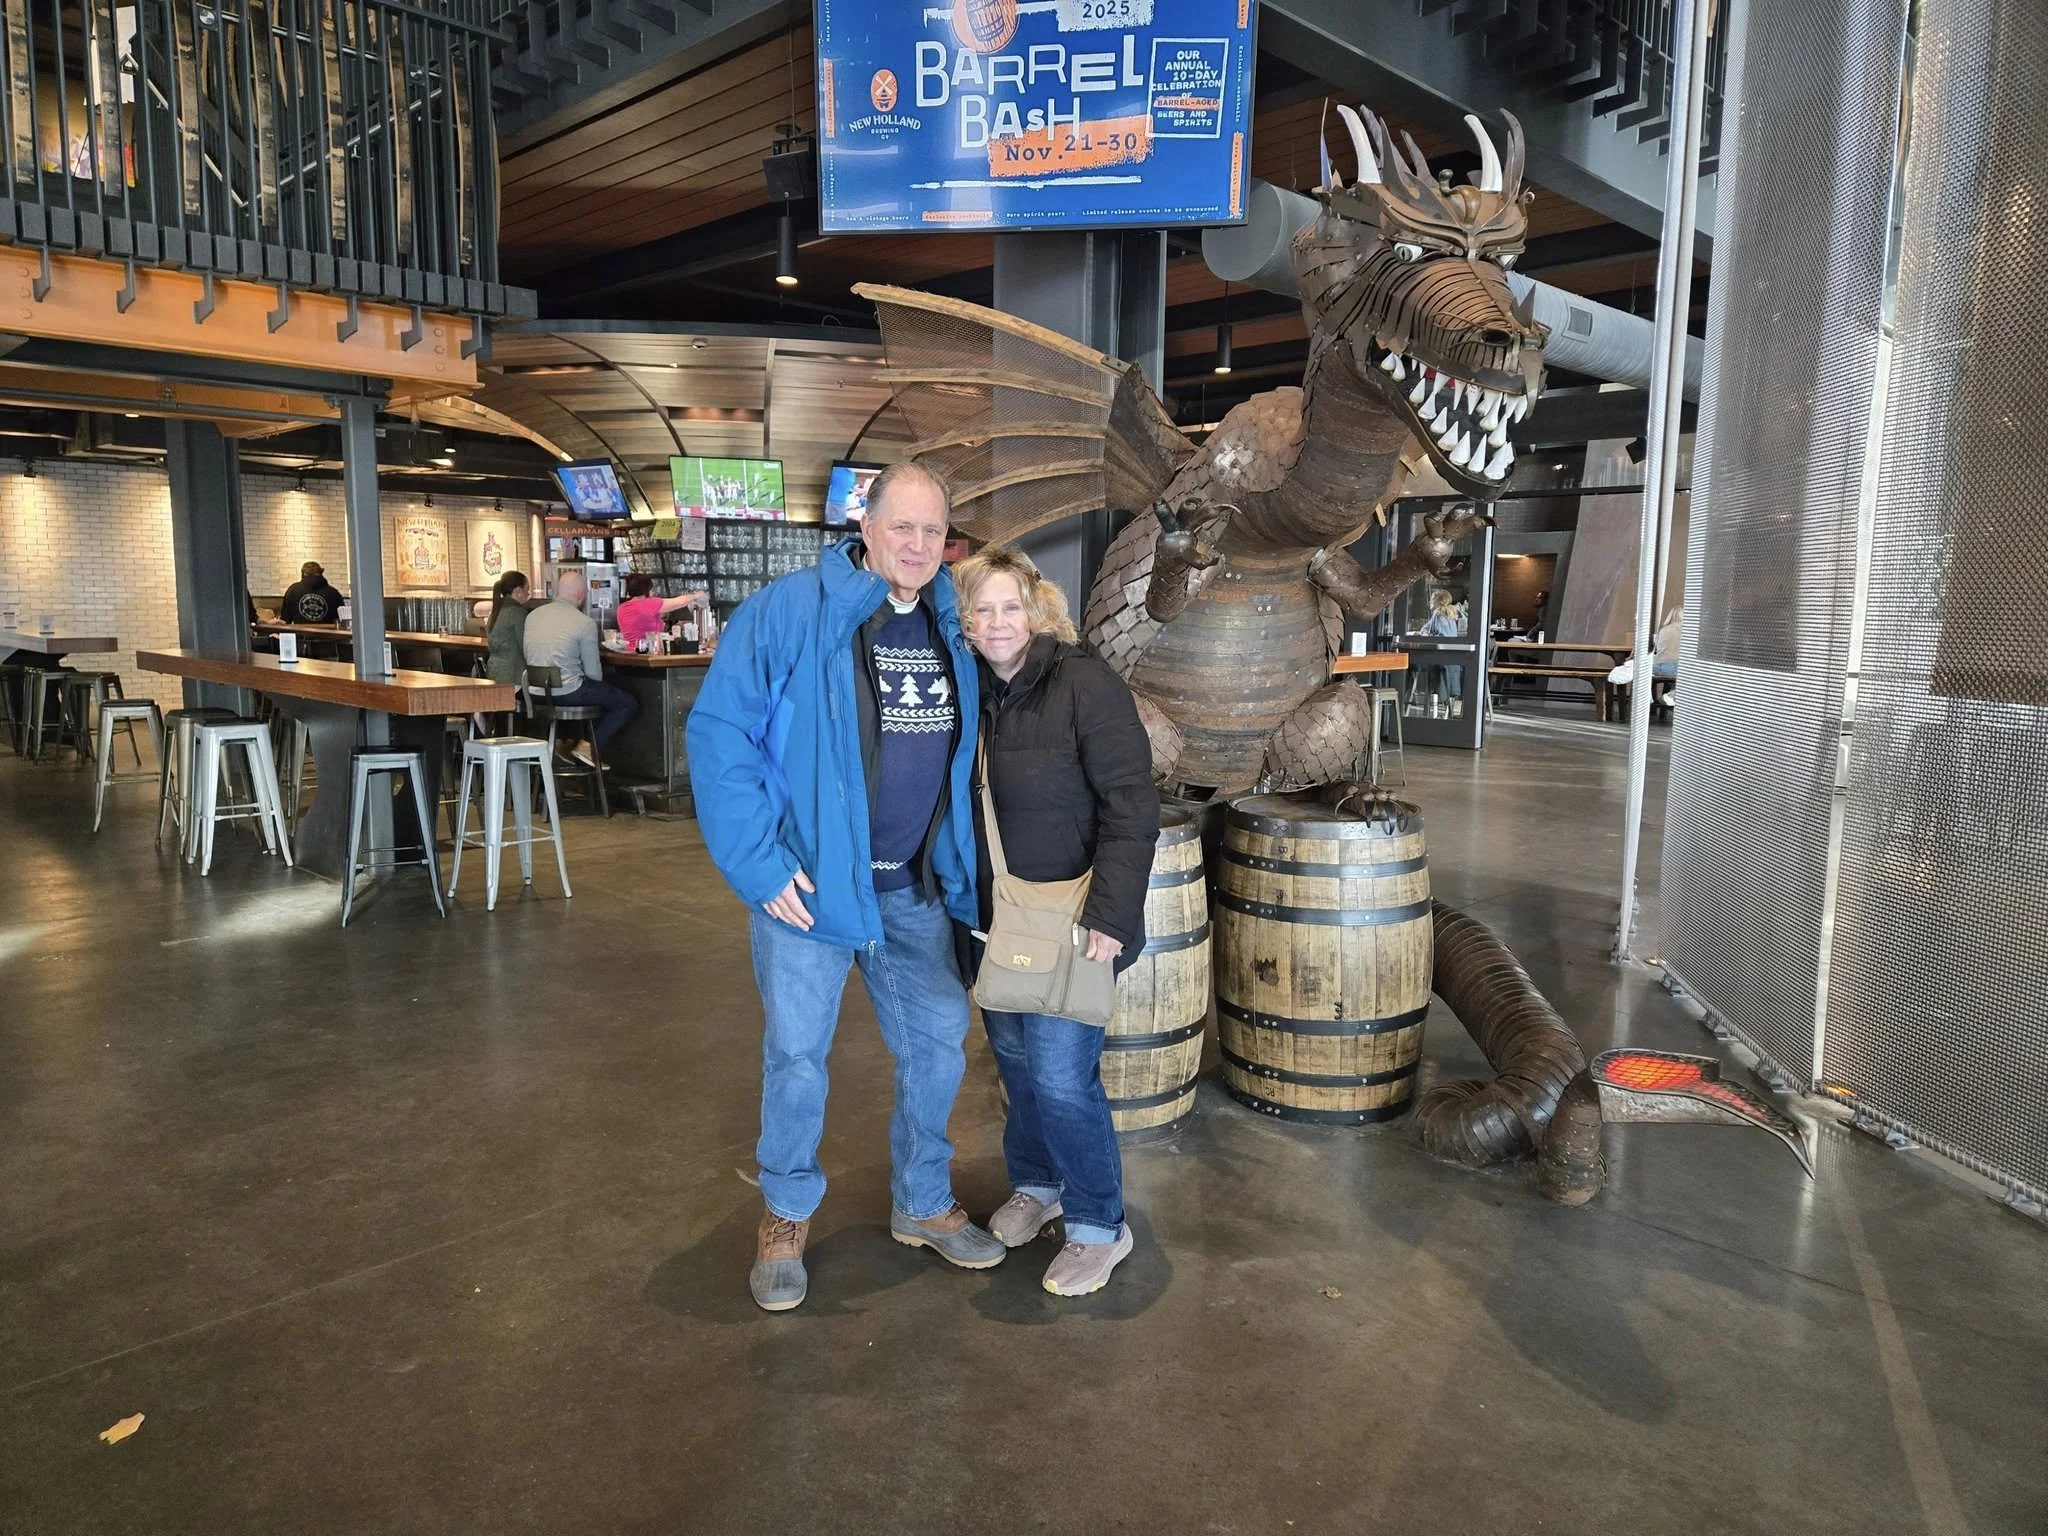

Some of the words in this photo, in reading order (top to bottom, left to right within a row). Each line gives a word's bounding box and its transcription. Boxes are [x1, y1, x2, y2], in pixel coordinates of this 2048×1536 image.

[1083, 0, 1130, 18] 2025
[1176, 50, 1200, 60] OUR
[915, 34, 1144, 107] BARREL
[1164, 60, 1211, 71] ANNUAL
[1173, 70, 1218, 81] 10-DAY
[1151, 79, 1222, 91] CELEBRATION
[1157, 110, 1185, 118] BEERS
[1190, 110, 1207, 118] AND
[849, 116, 872, 132] NEW
[873, 114, 921, 130] HOLLAND
[1064, 132, 1137, 151] 21-30
